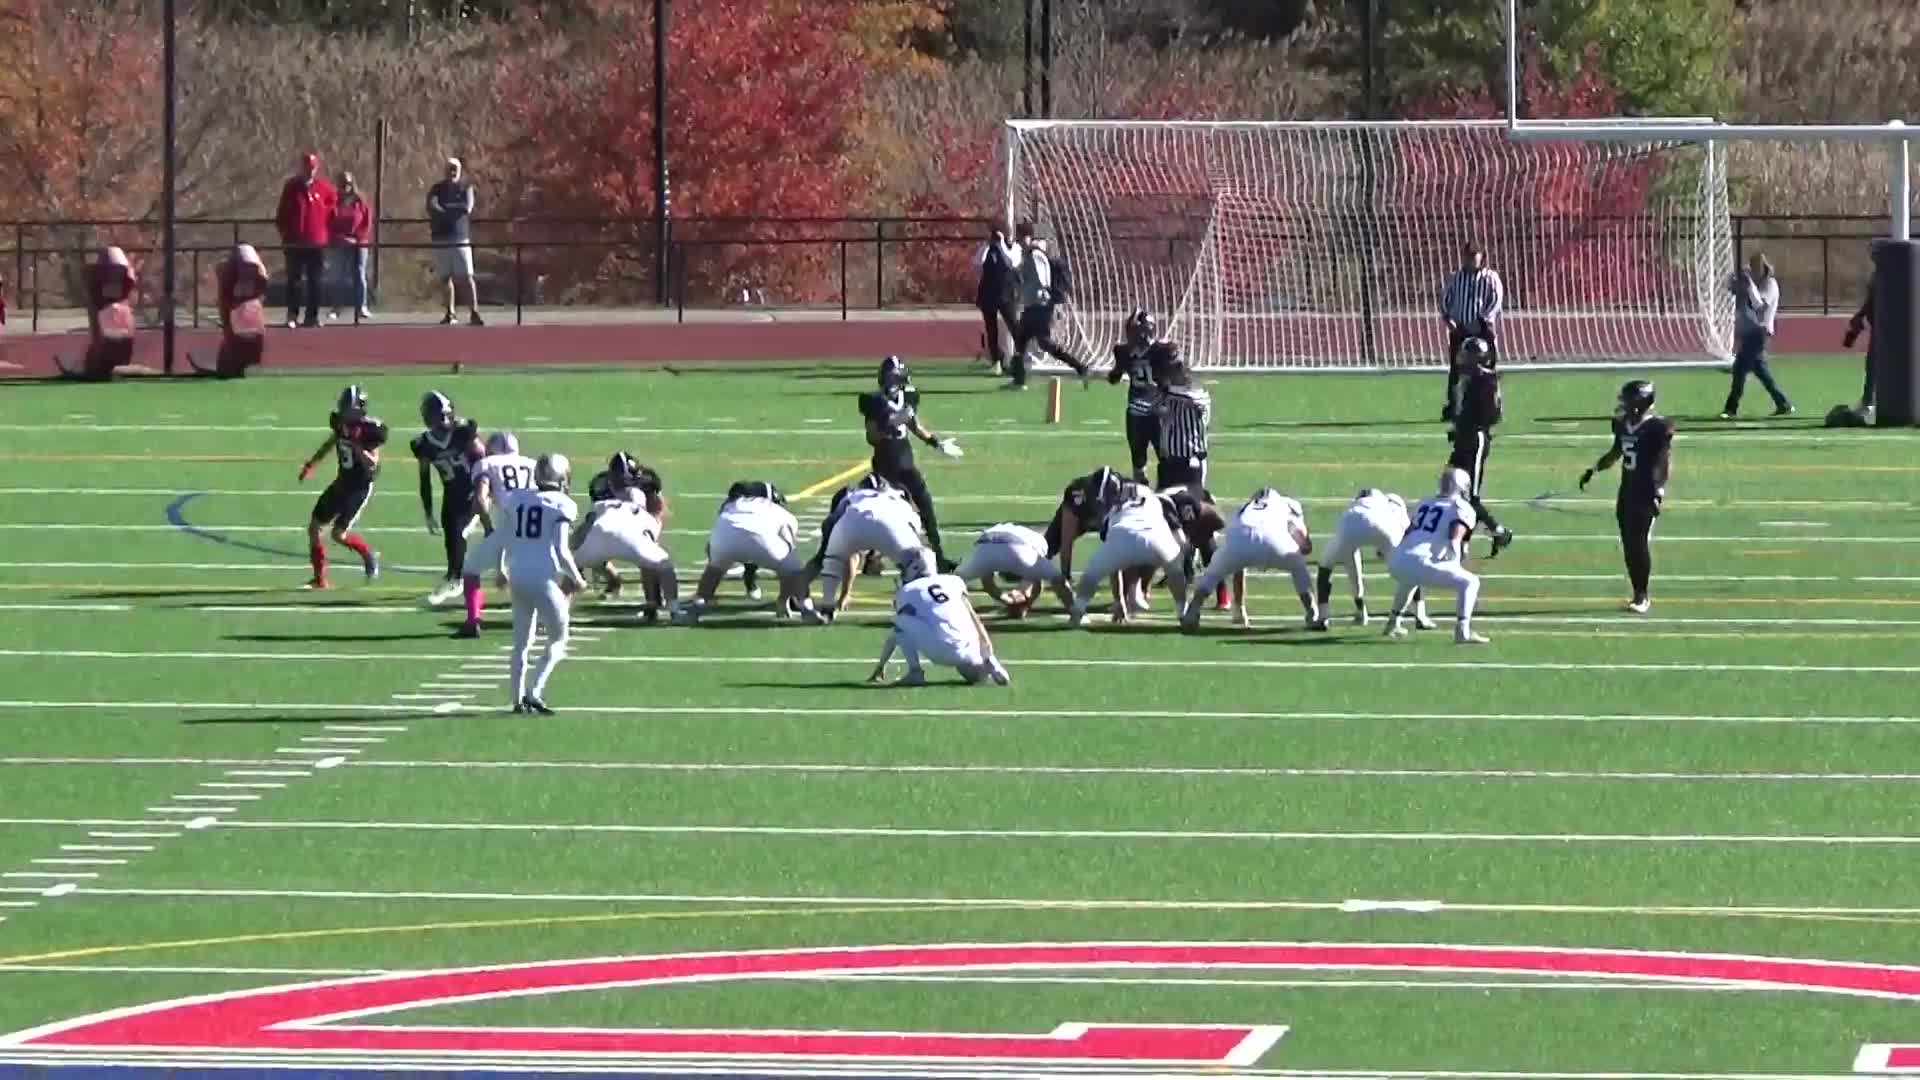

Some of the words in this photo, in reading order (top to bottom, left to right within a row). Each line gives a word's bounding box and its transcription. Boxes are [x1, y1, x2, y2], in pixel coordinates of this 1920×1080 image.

[1622, 442, 1637, 470] 5
[502, 465, 530, 491] 87
[515, 504, 543, 537] 18
[1413, 504, 1444, 533] 33
[927, 584, 949, 604] 6
